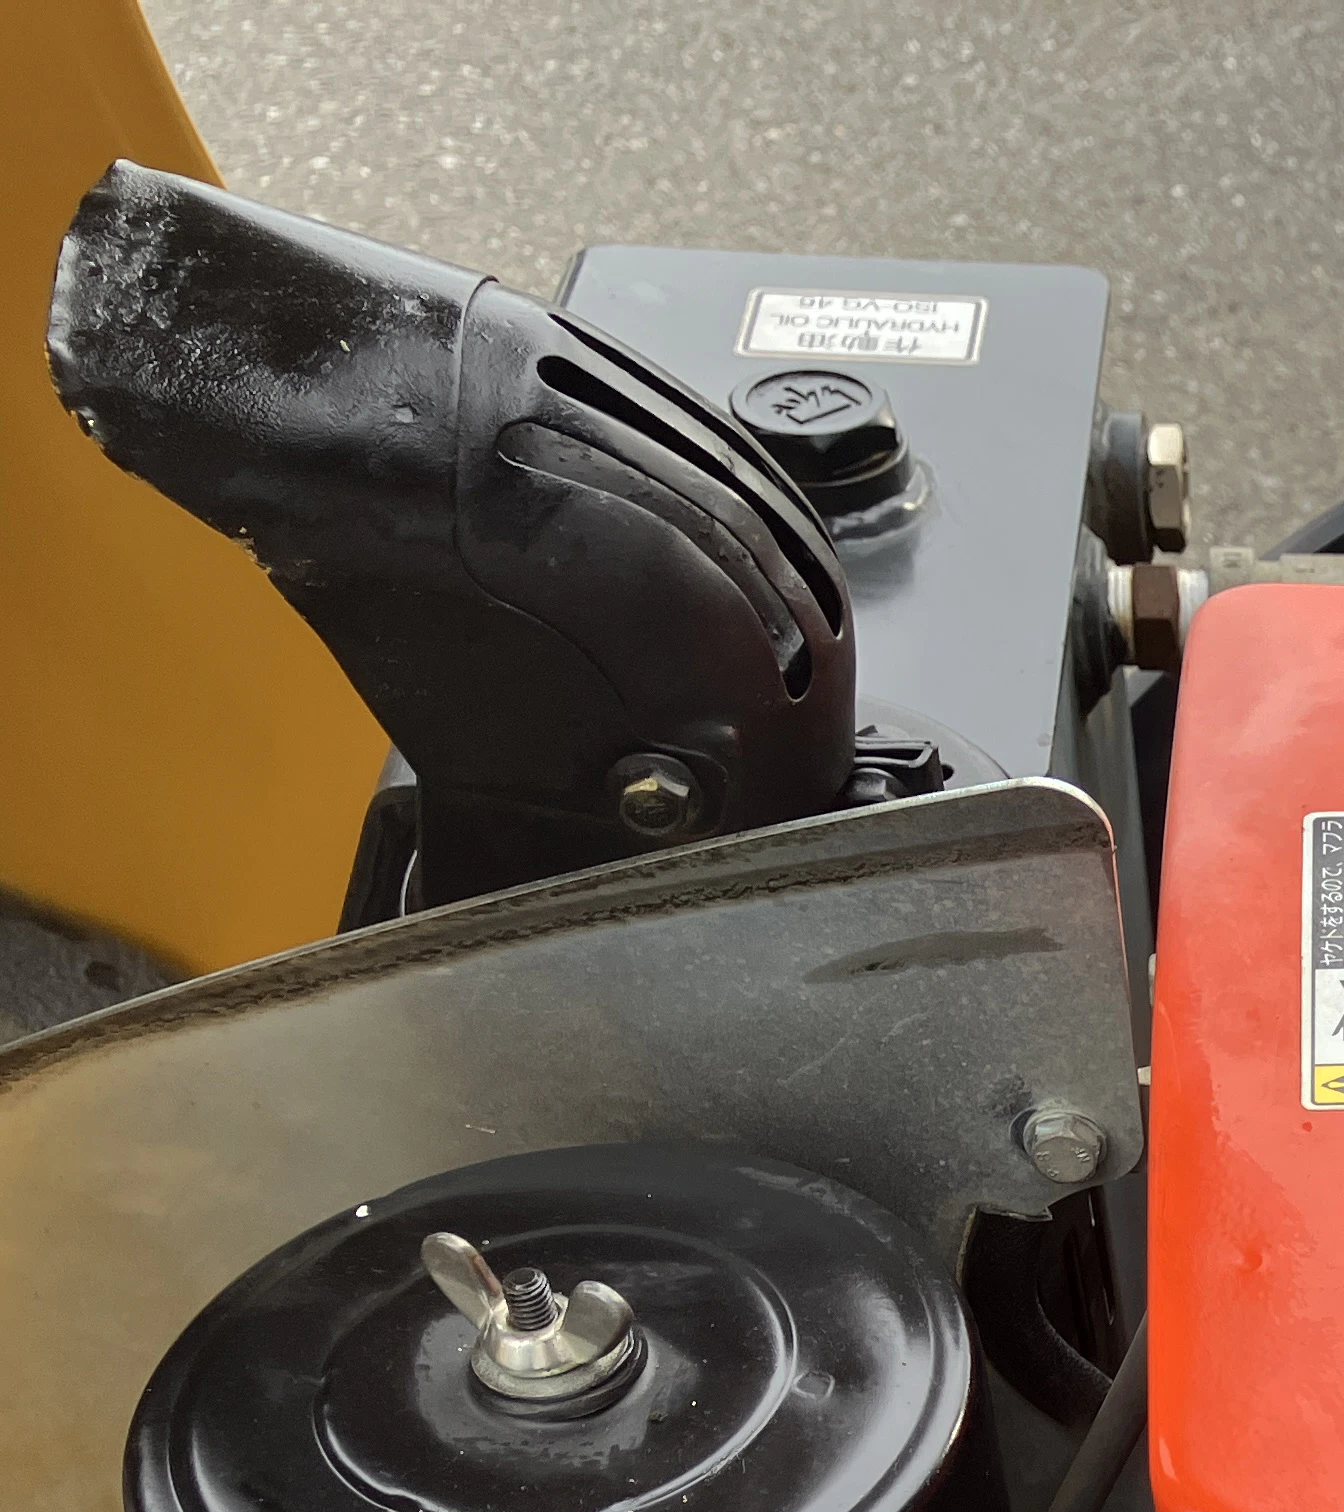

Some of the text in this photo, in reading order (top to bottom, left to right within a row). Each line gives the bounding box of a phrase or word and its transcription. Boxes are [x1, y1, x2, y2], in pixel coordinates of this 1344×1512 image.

[771, 313, 810, 327] OIL
[1320, 820, 1344, 966] ヤケドをするので、マフラ
